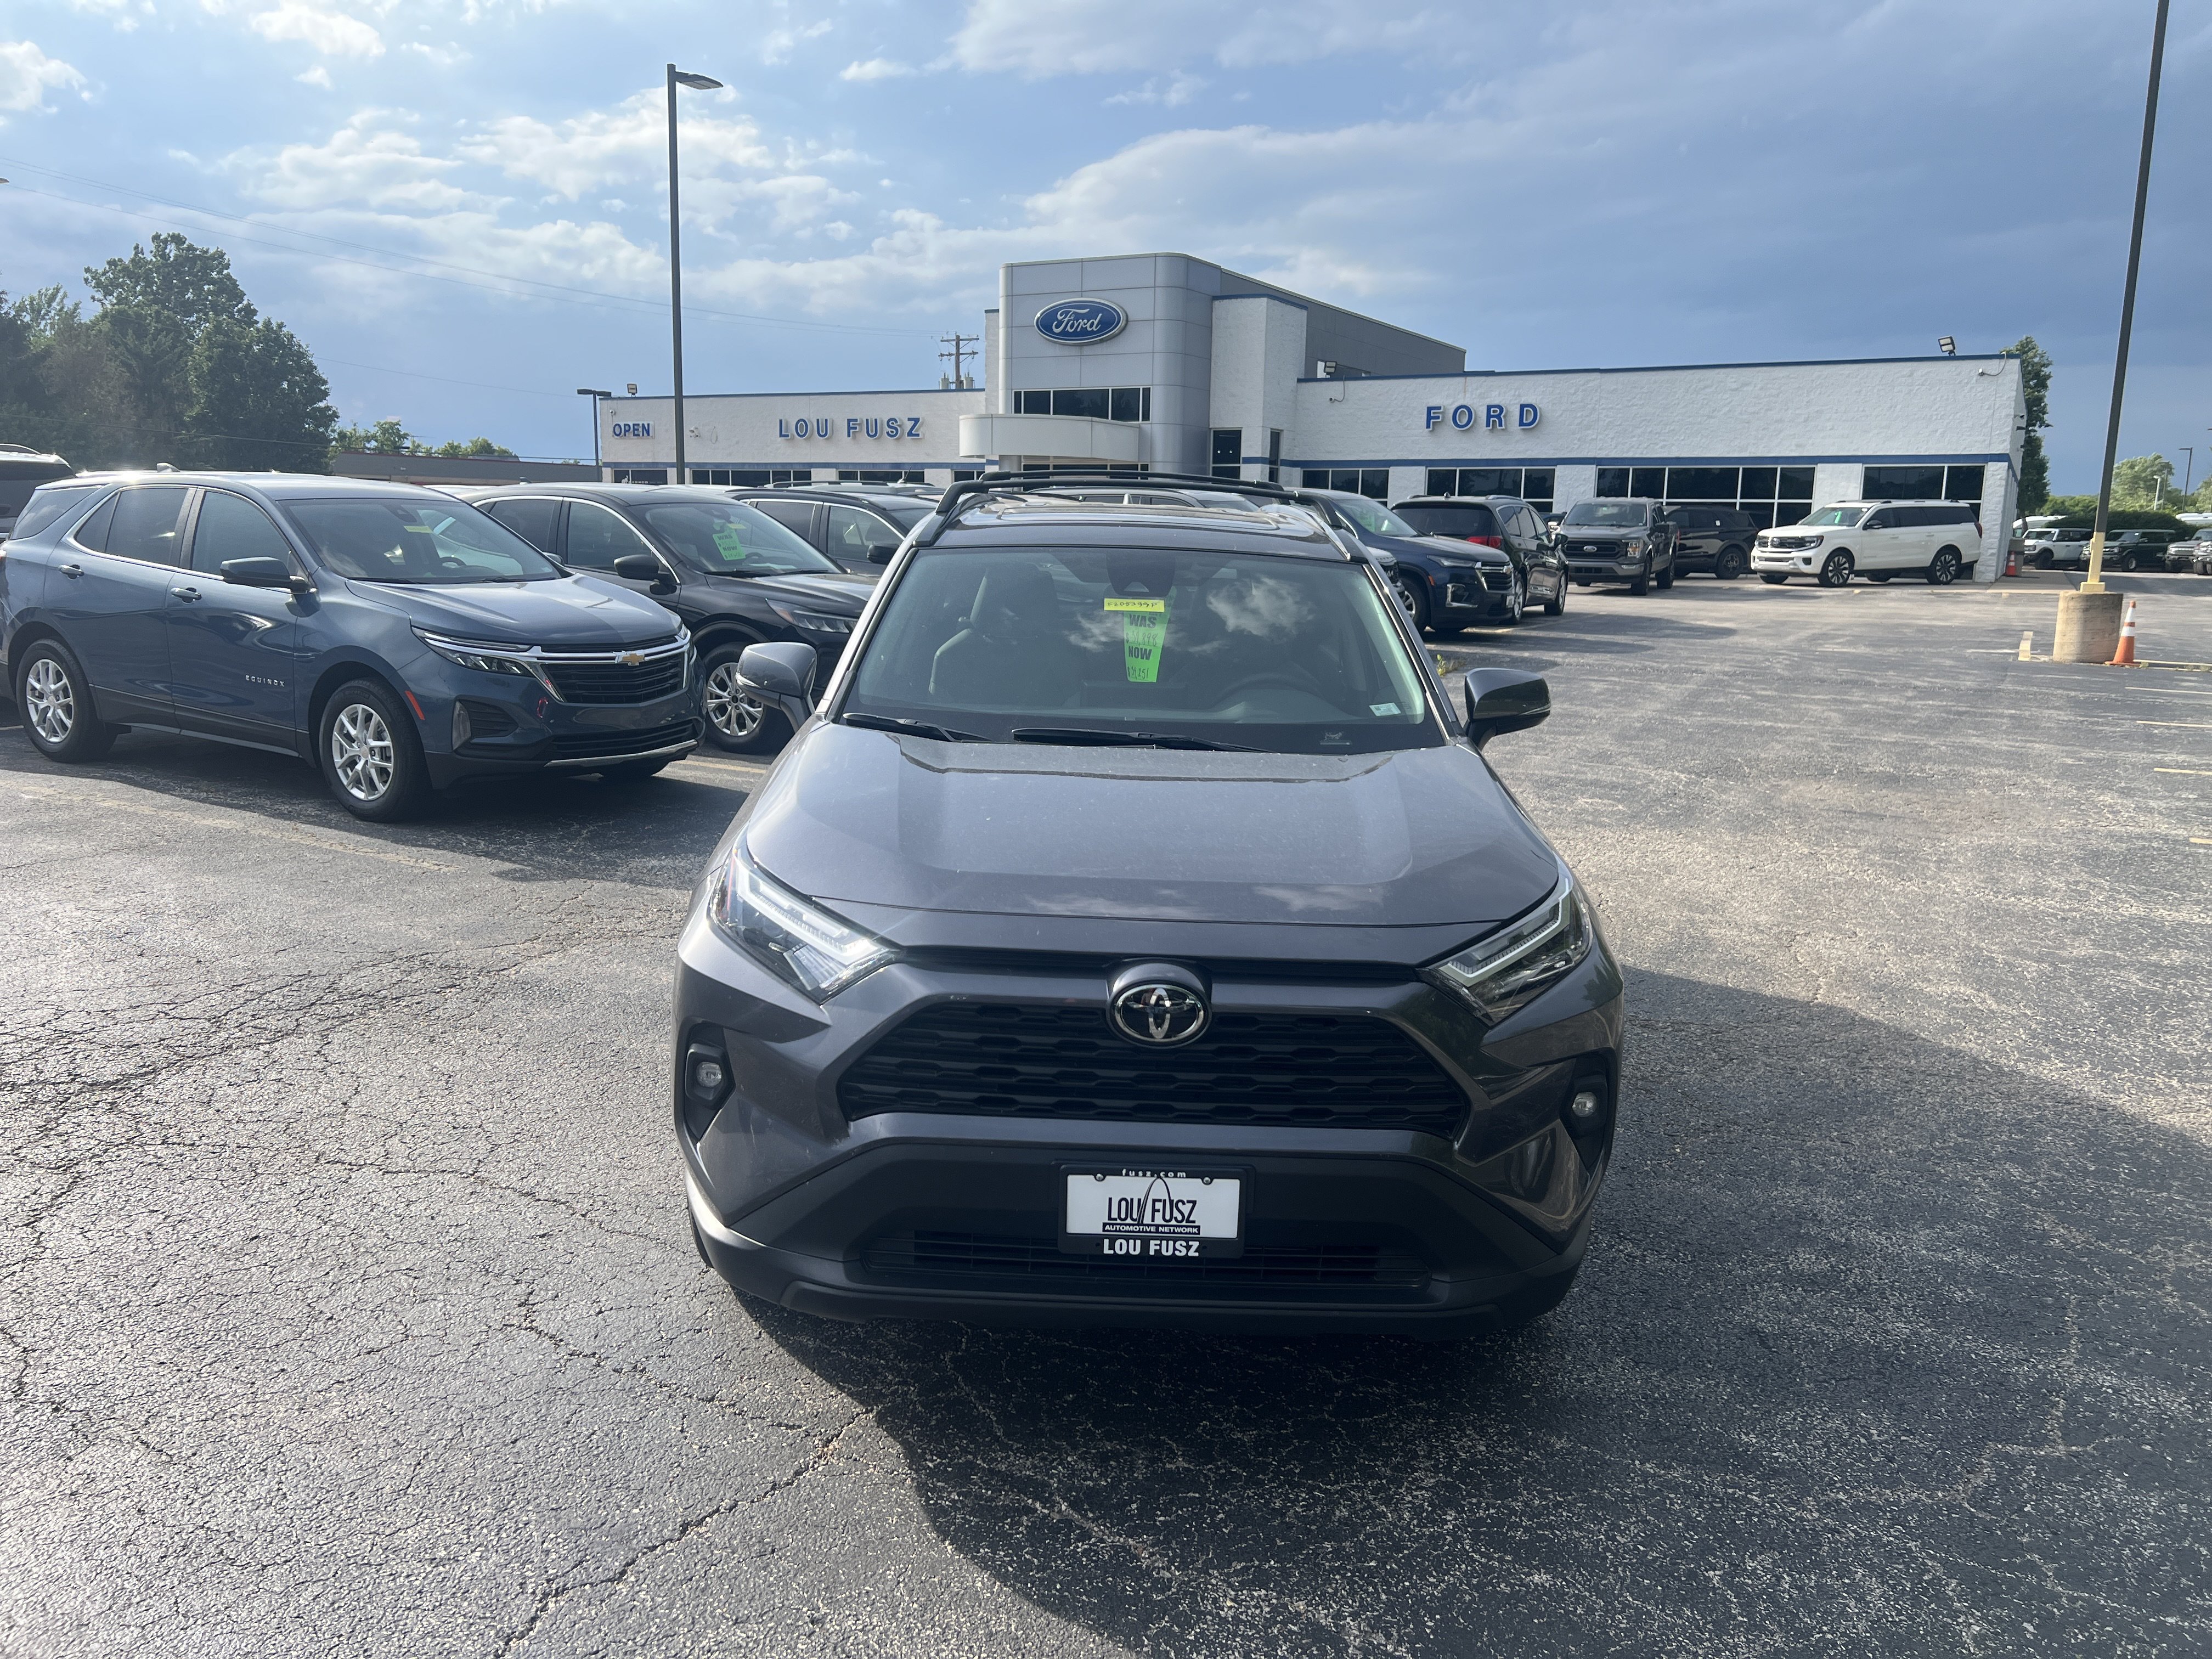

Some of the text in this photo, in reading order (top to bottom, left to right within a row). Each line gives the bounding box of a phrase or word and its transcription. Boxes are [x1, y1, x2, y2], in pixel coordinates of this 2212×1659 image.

[1052, 308, 1103, 333] Ford
[1425, 403, 1539, 430] FORD
[613, 423, 650, 437] OPEN
[778, 417, 921, 438] LOU FUSZ
[1130, 614, 1157, 629] WAS
[1128, 646, 1152, 661] NOW
[245, 675, 285, 687] EQUINOX
[1122, 1169, 1186, 1178] fusz.com
[1108, 1197, 1197, 1224] LOU FUSZ
[1103, 1238, 1200, 1256] LOU FUSZ
